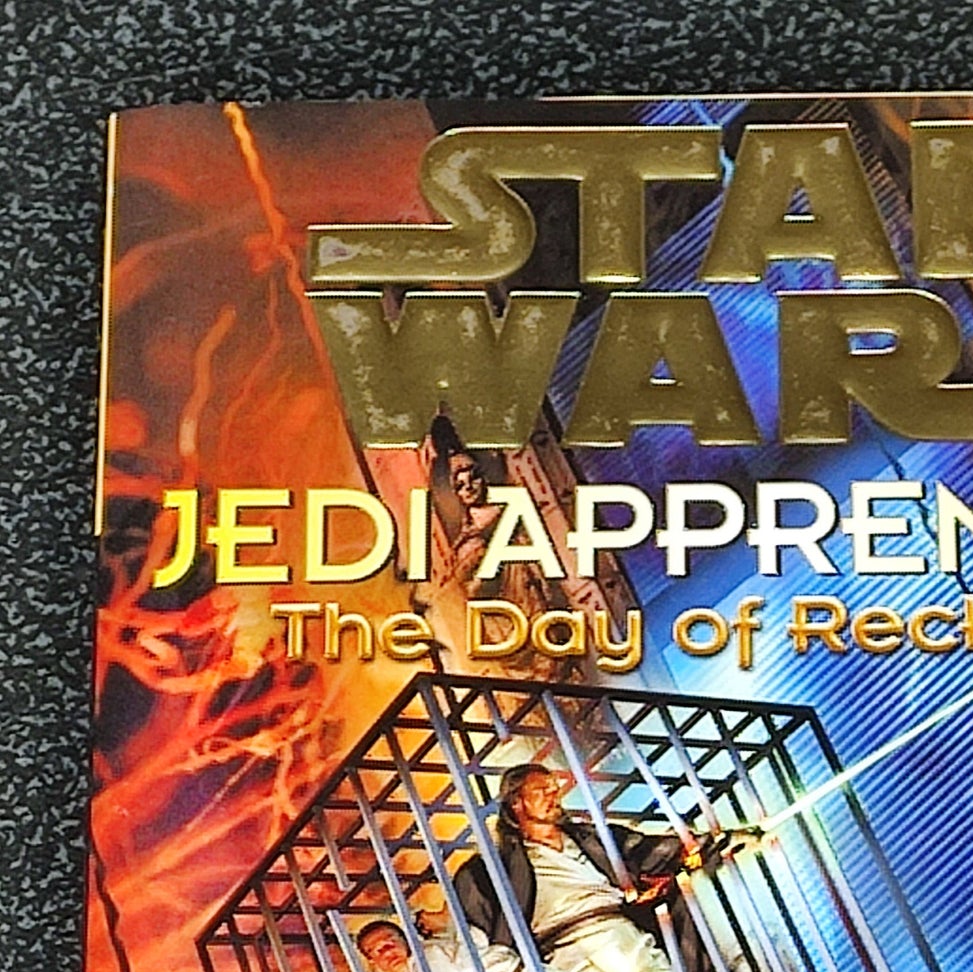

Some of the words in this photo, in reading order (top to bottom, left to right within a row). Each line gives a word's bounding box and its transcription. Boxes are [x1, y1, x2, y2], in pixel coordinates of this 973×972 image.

[152, 487, 430, 589] JEDI
[270, 601, 436, 662] The
[464, 598, 643, 672] Day
[673, 595, 767, 671] of
